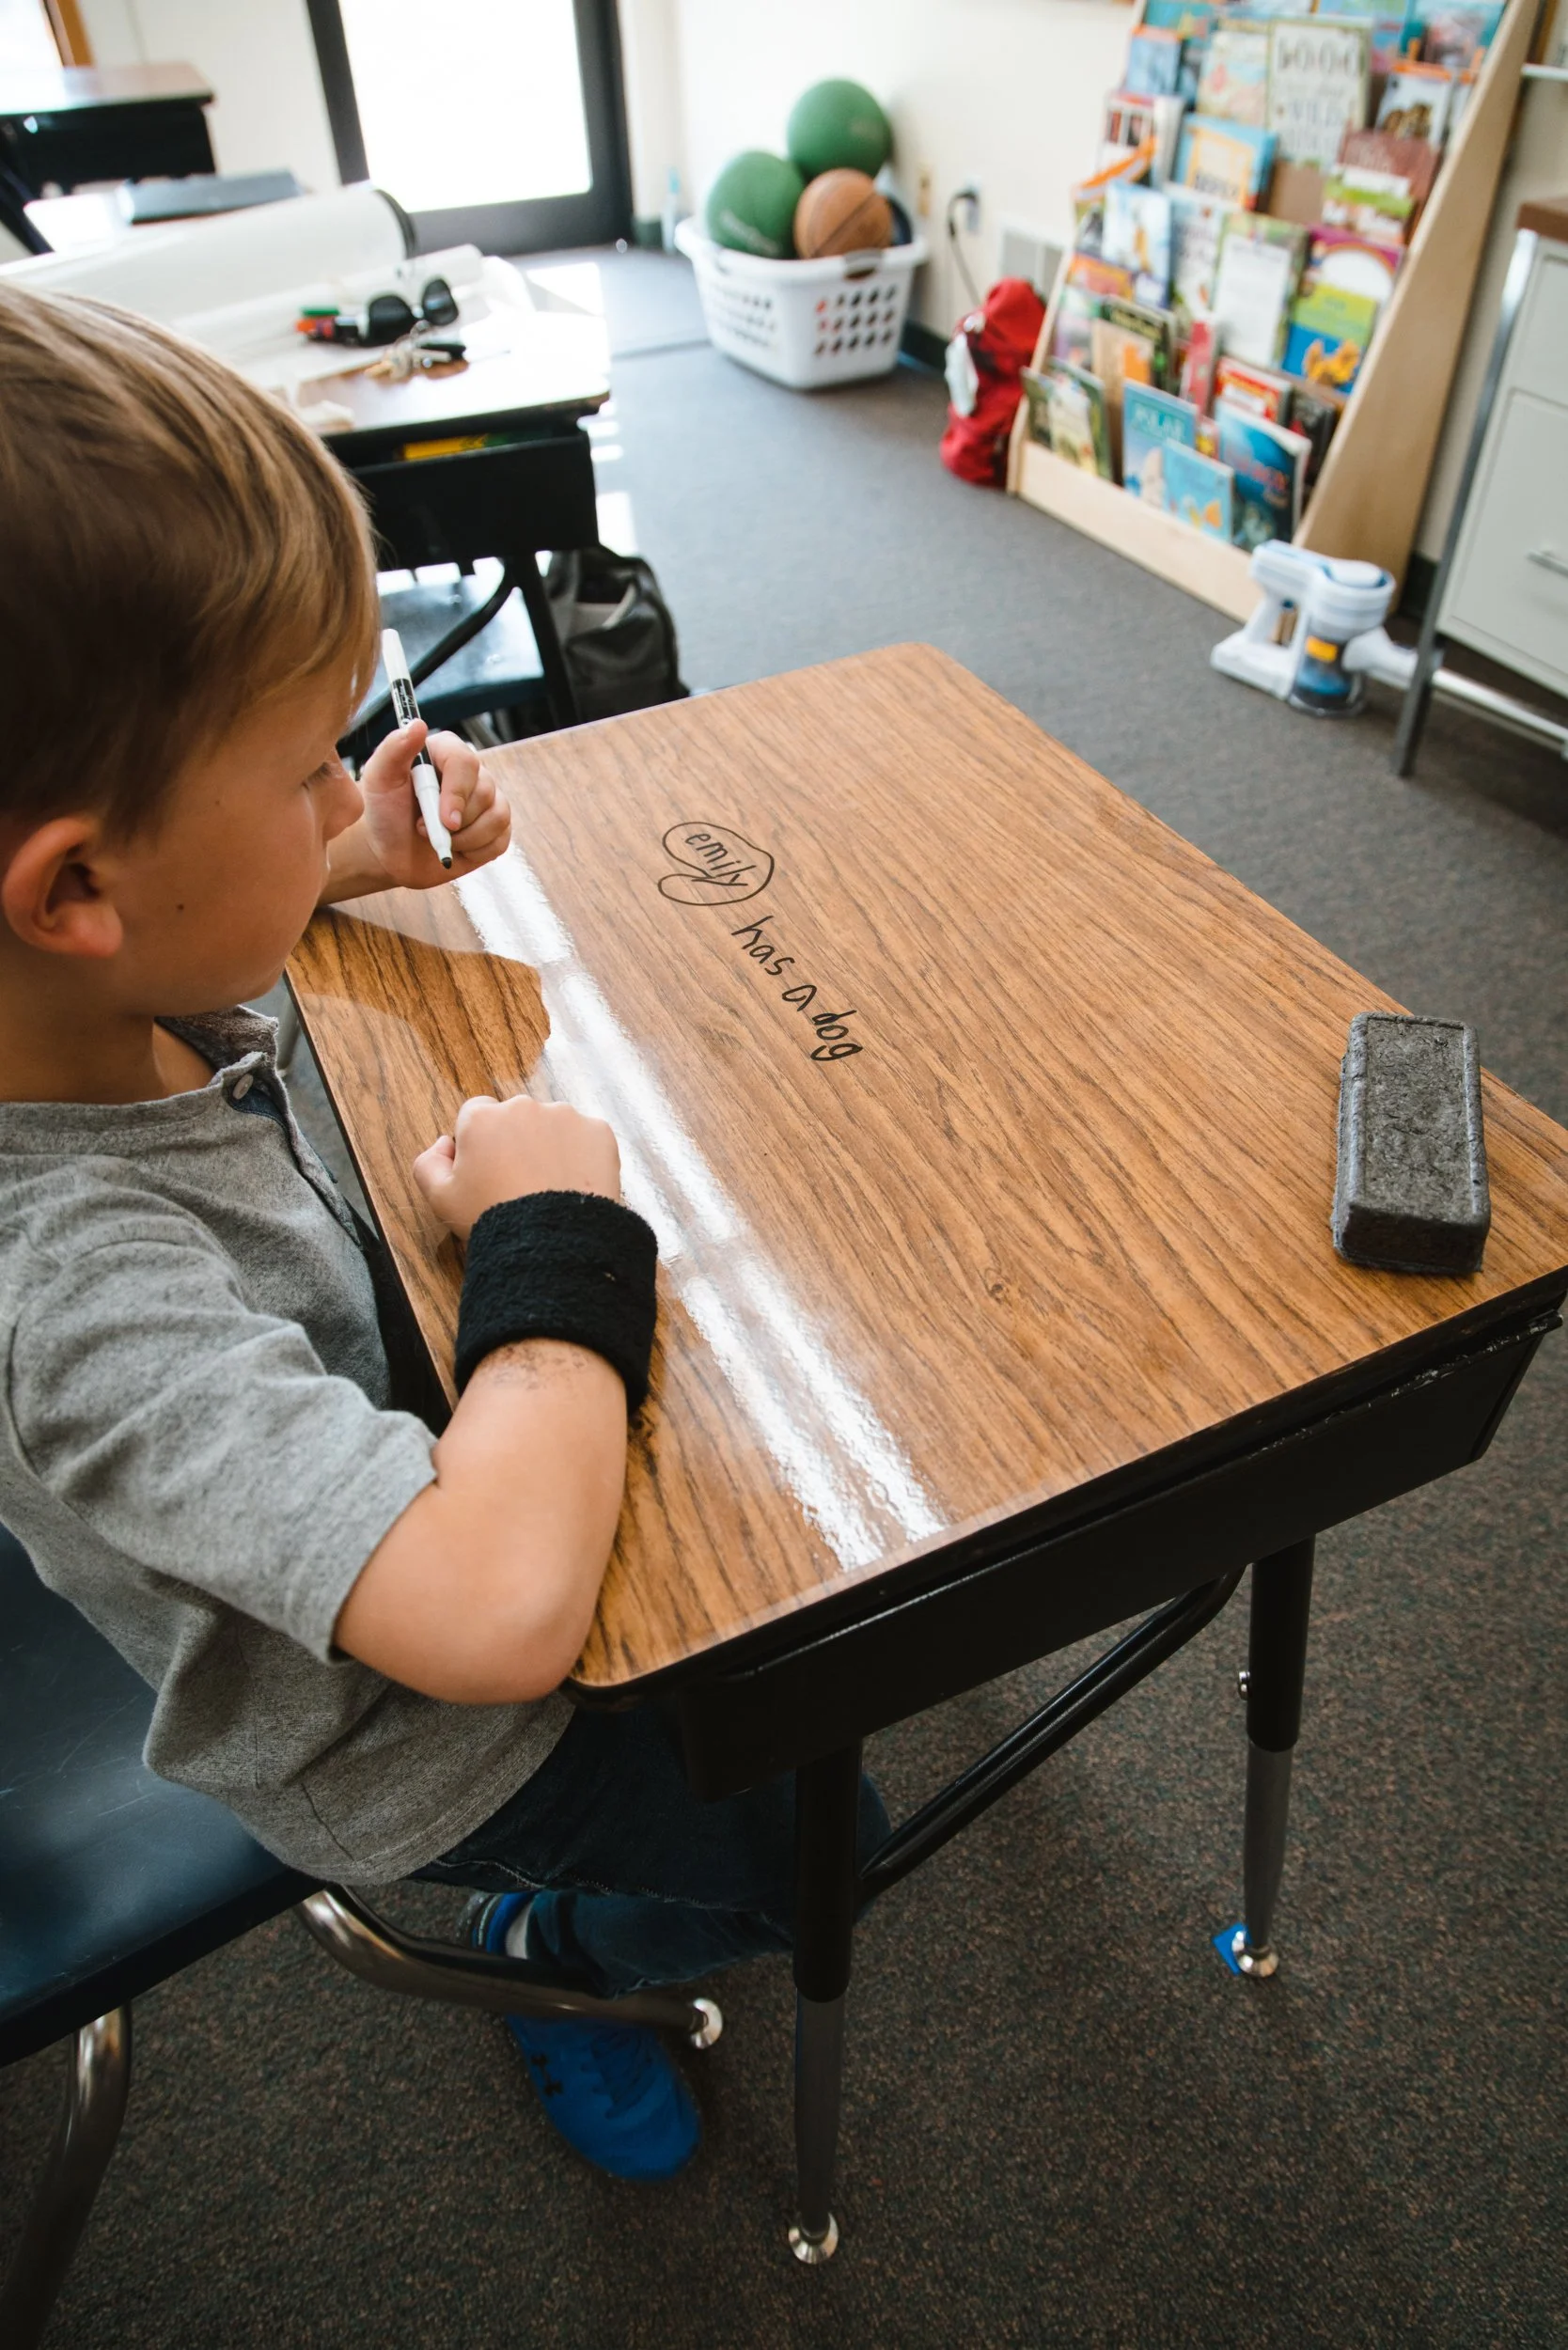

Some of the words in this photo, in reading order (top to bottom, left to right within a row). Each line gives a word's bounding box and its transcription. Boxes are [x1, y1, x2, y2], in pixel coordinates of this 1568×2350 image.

[685, 833, 757, 886] emily
[730, 915, 795, 976] has
[781, 984, 817, 1012] a
[809, 1010, 863, 1061] dog
